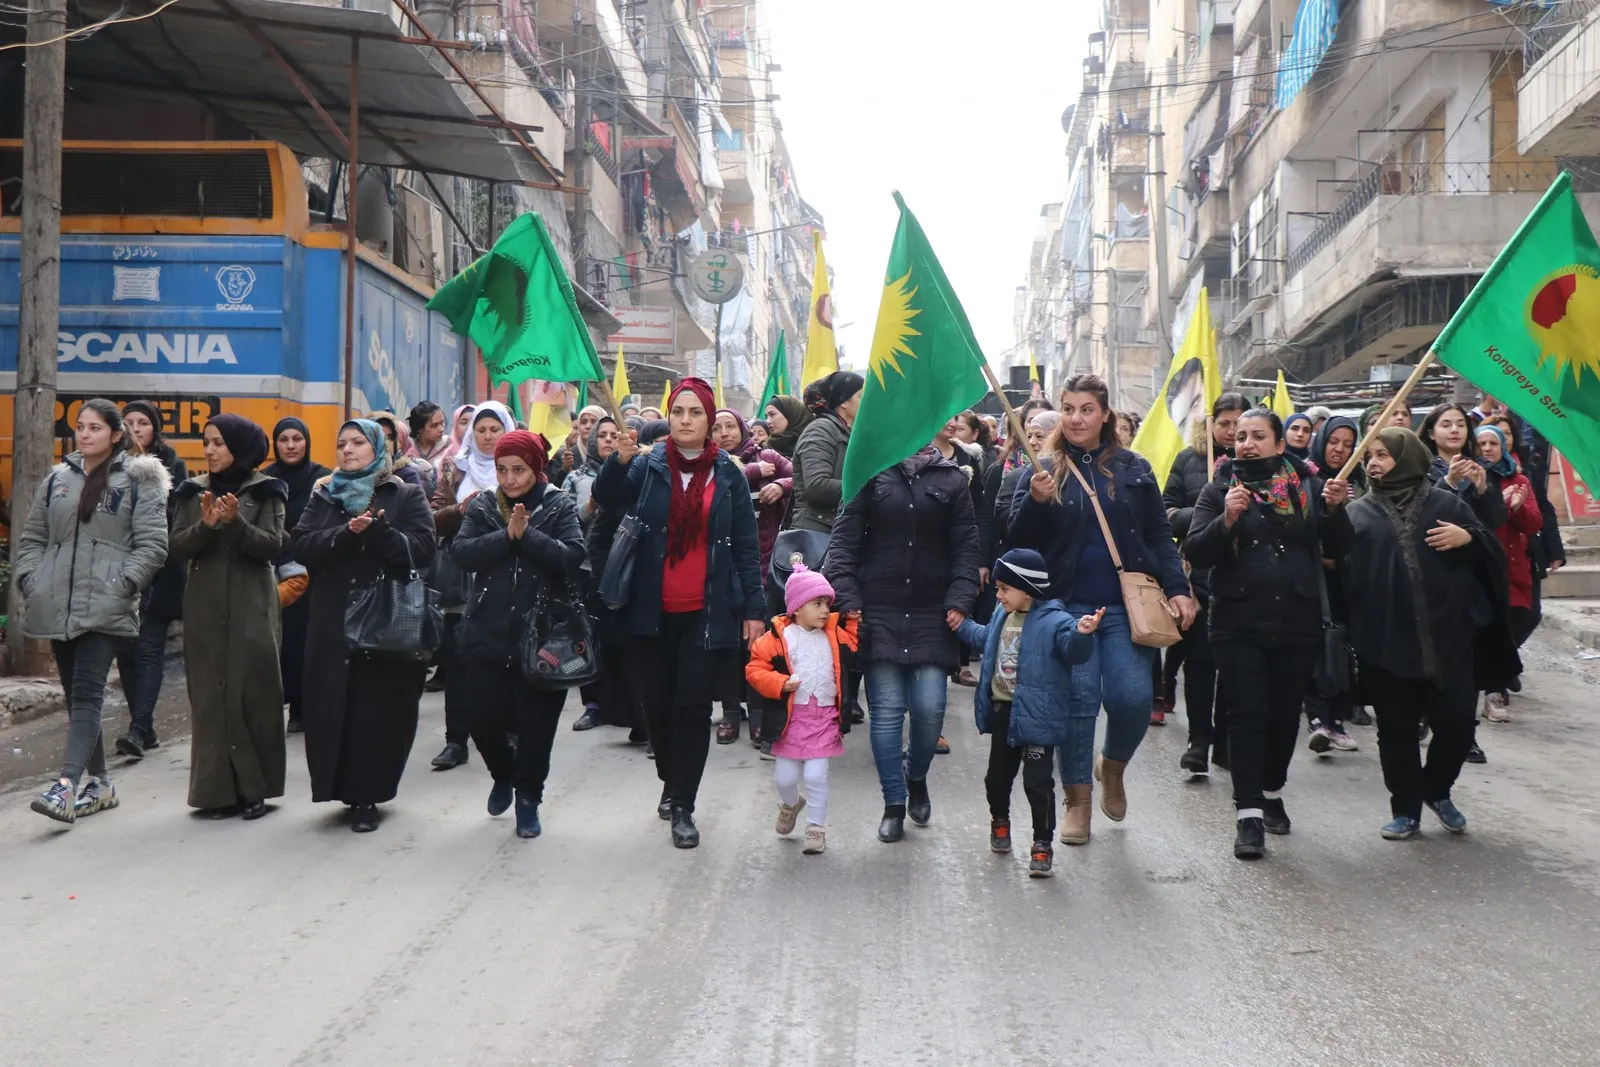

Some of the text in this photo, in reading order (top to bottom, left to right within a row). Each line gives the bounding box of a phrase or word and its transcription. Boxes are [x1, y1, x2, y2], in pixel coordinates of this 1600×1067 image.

[216, 303, 254, 311] SCANIA
[57, 332, 238, 364] SCANIA
[1484, 345, 1567, 419] Kongreya Star
